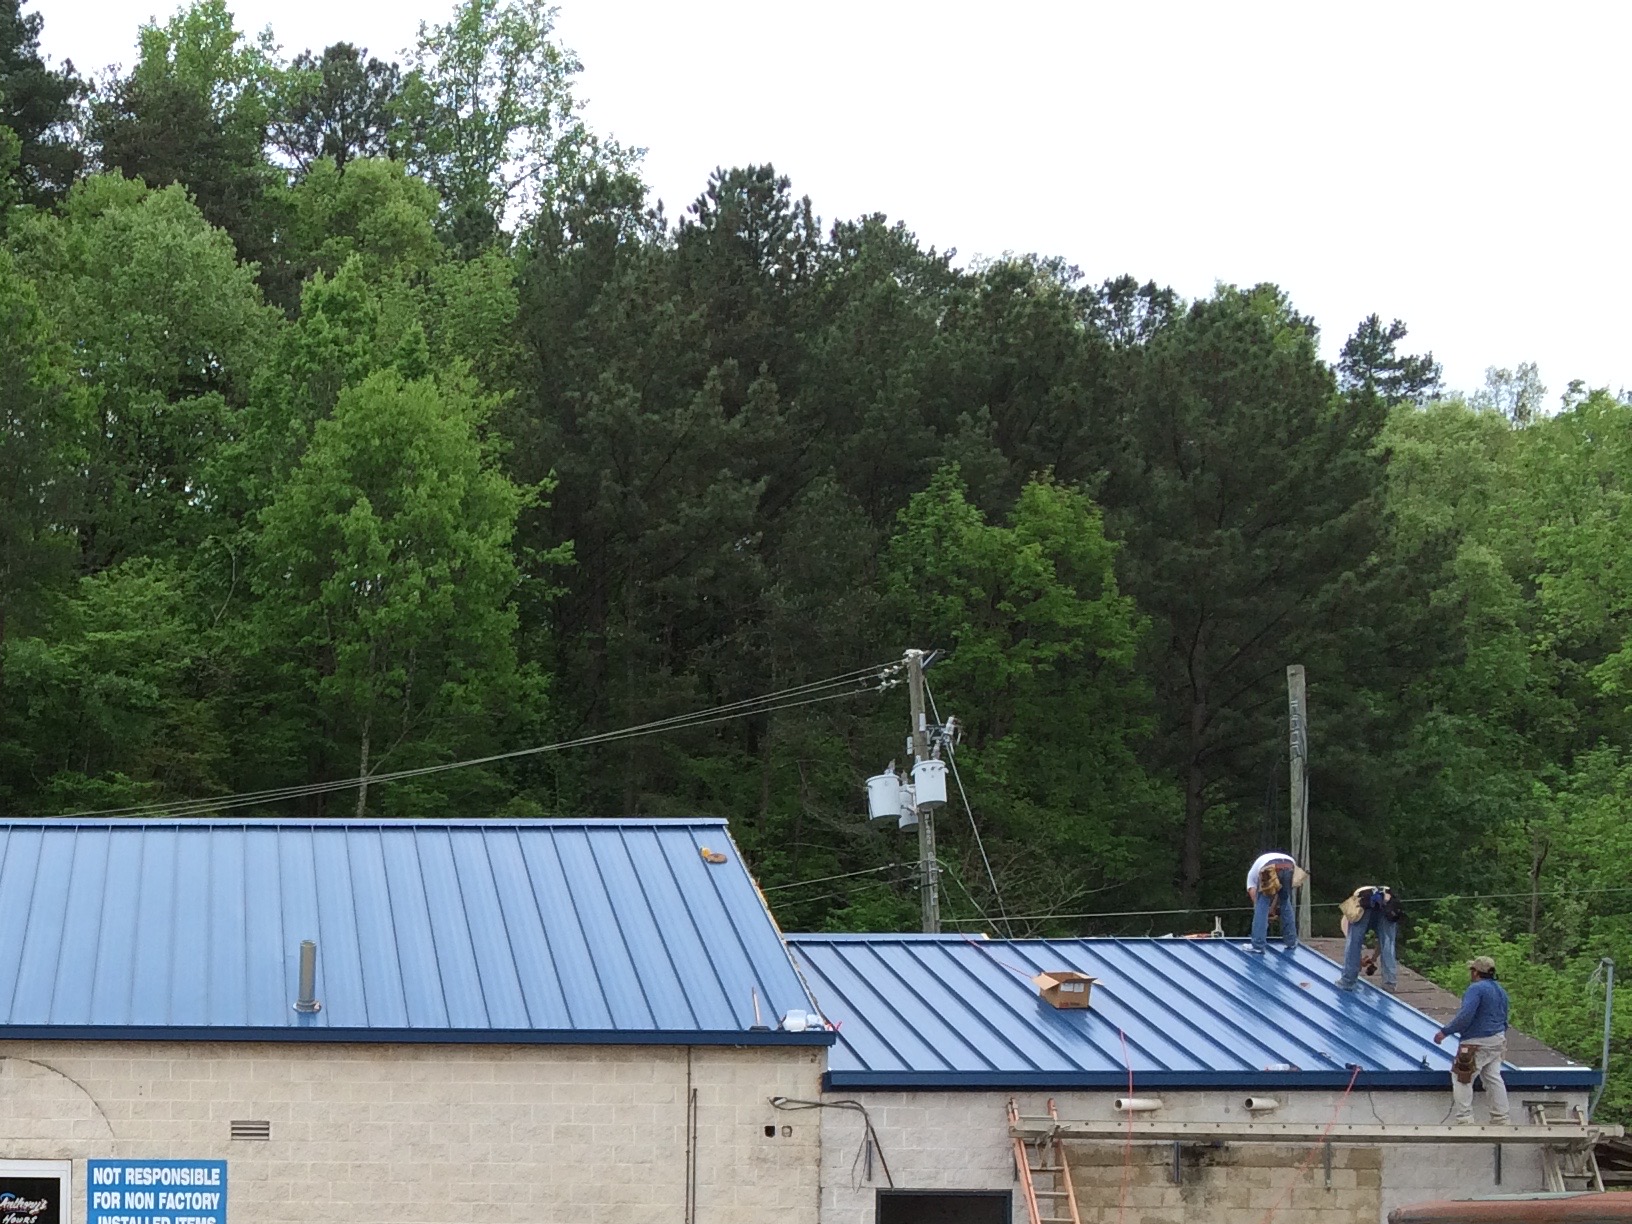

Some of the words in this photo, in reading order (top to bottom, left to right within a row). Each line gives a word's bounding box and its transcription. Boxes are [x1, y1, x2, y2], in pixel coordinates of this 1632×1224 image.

[93, 1167, 121, 1185] NOT
[125, 1167, 220, 1186] RESPONSIBLE
[93, 1191, 120, 1209] FOR
[125, 1192, 154, 1210] NON
[158, 1192, 220, 1210] FACTORY
